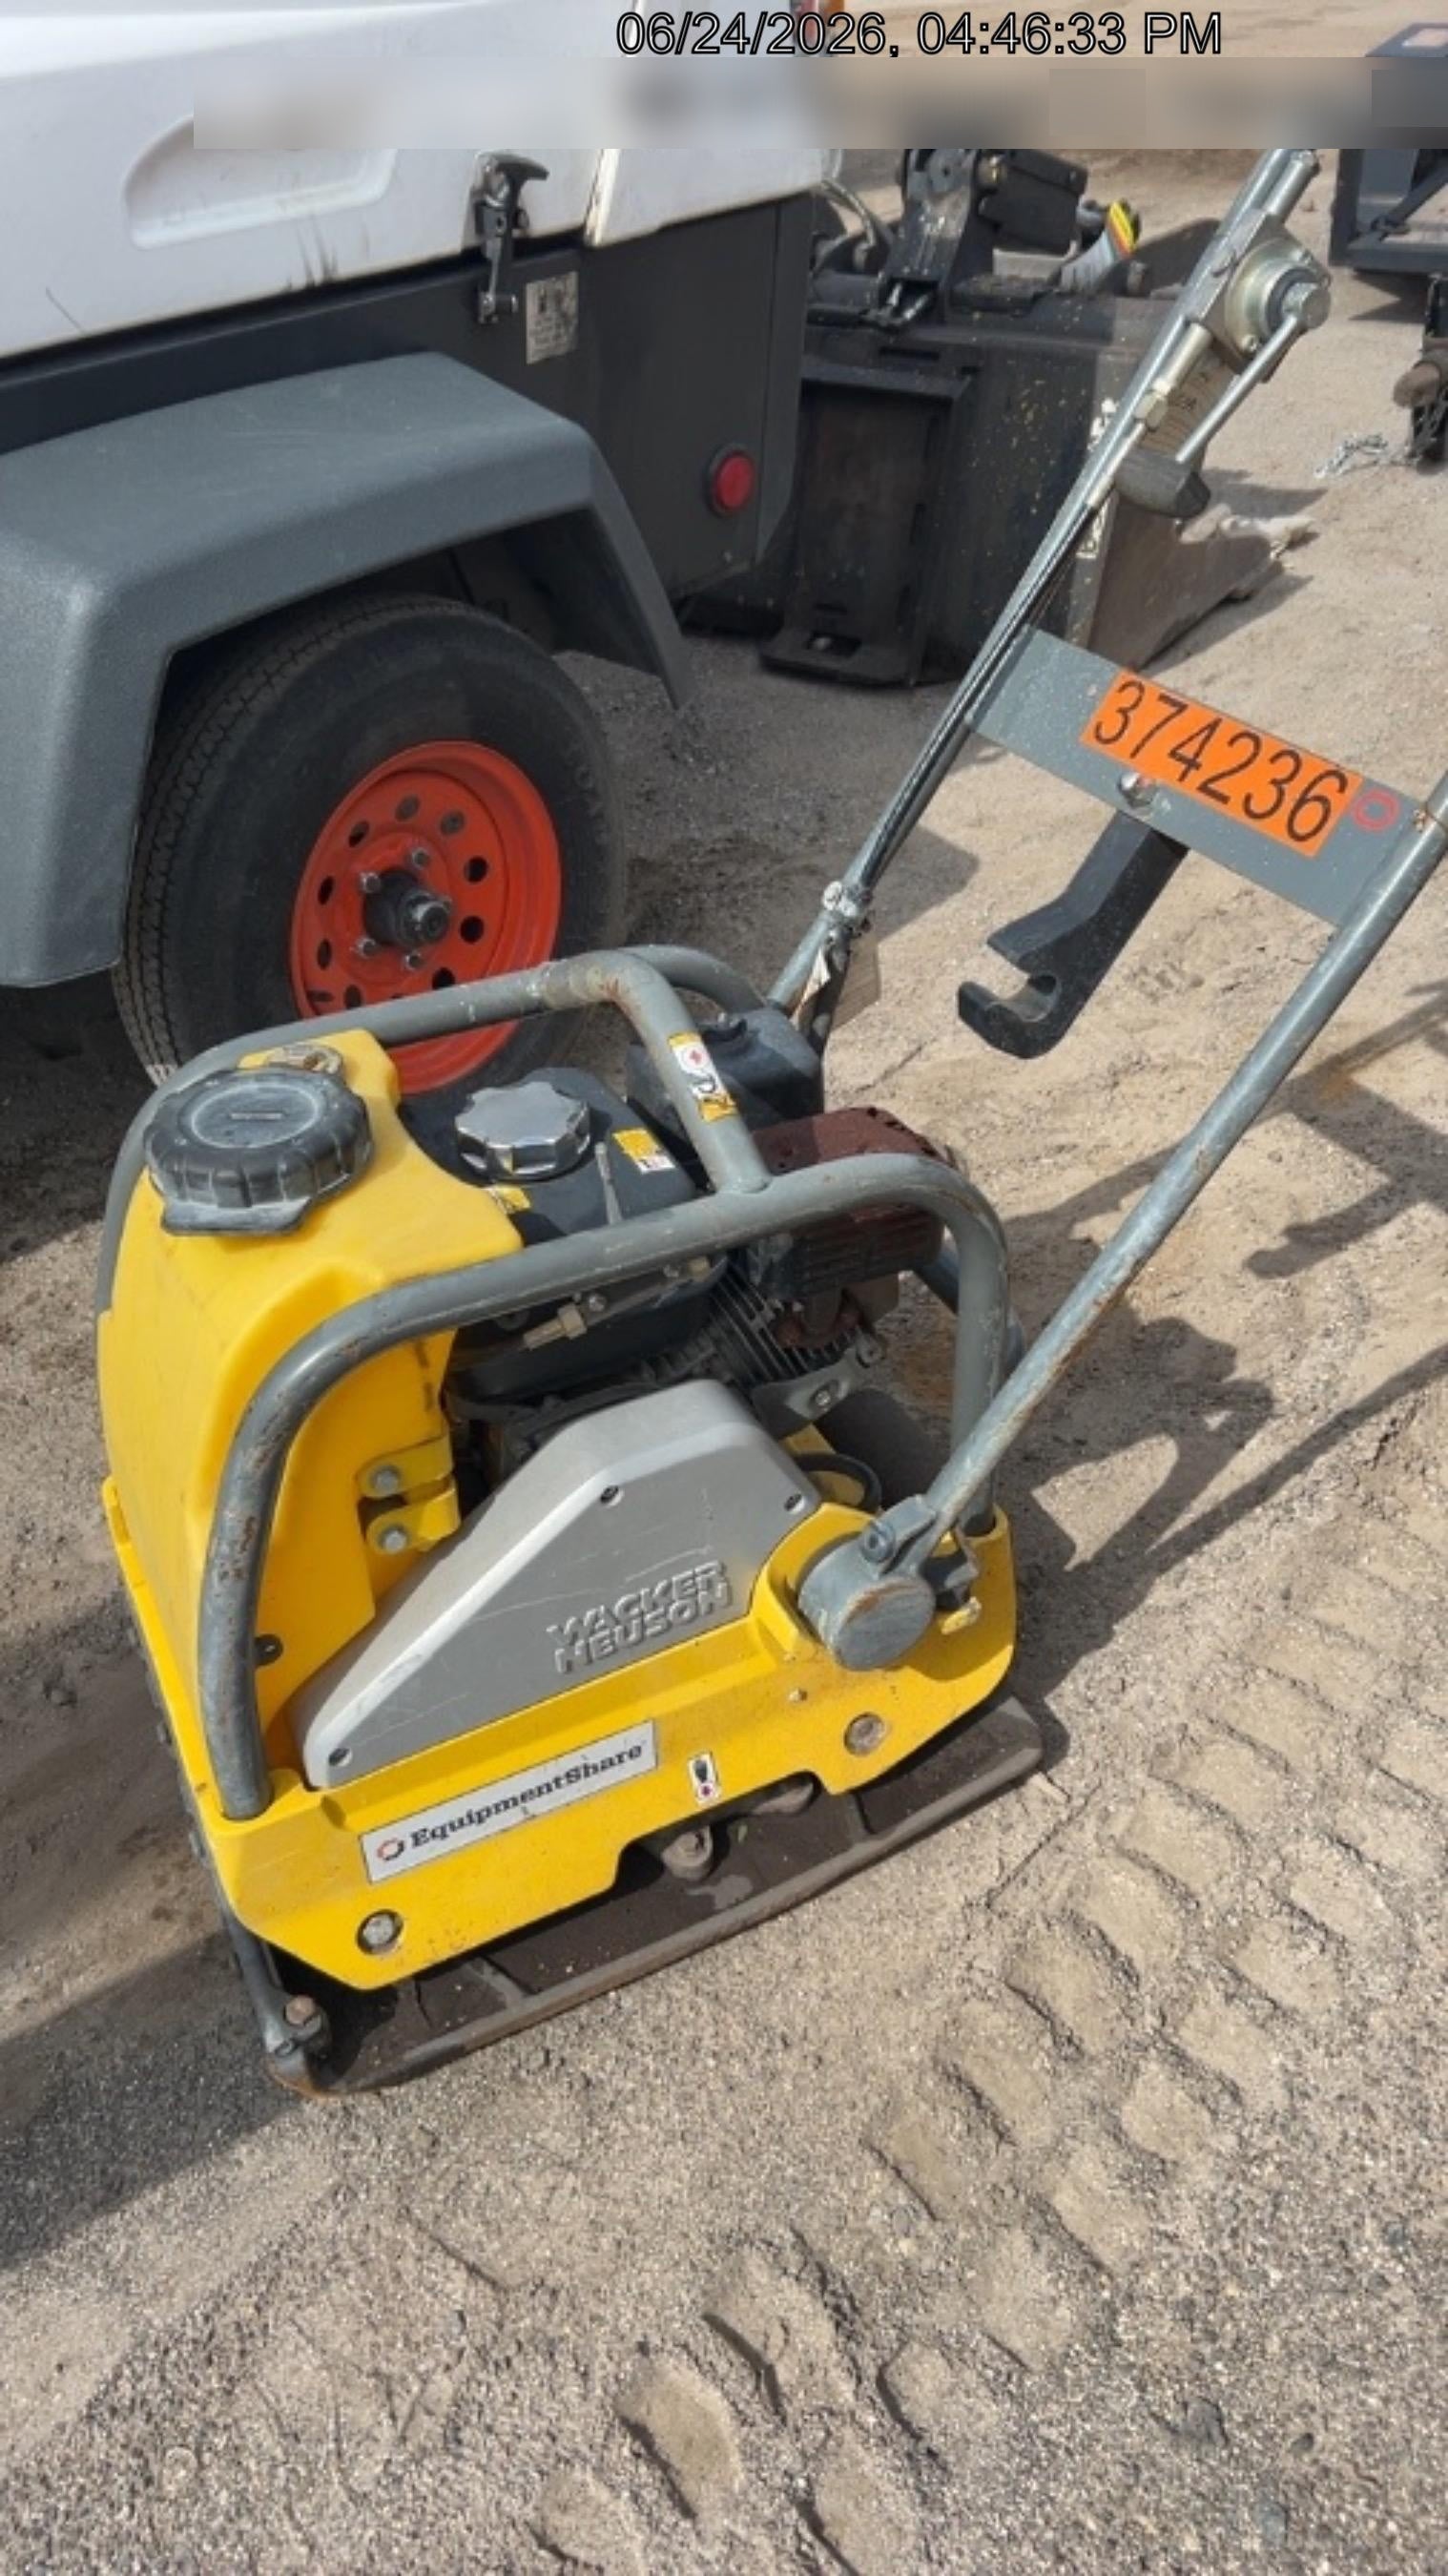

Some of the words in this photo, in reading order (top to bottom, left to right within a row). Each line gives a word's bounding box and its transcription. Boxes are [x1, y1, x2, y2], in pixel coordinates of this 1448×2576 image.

[1094, 680, 1348, 842] 374236
[547, 1560, 728, 1648] WACKER
[554, 1581, 733, 1674] NEUSON
[410, 1745, 642, 1848] EquipmentShare
